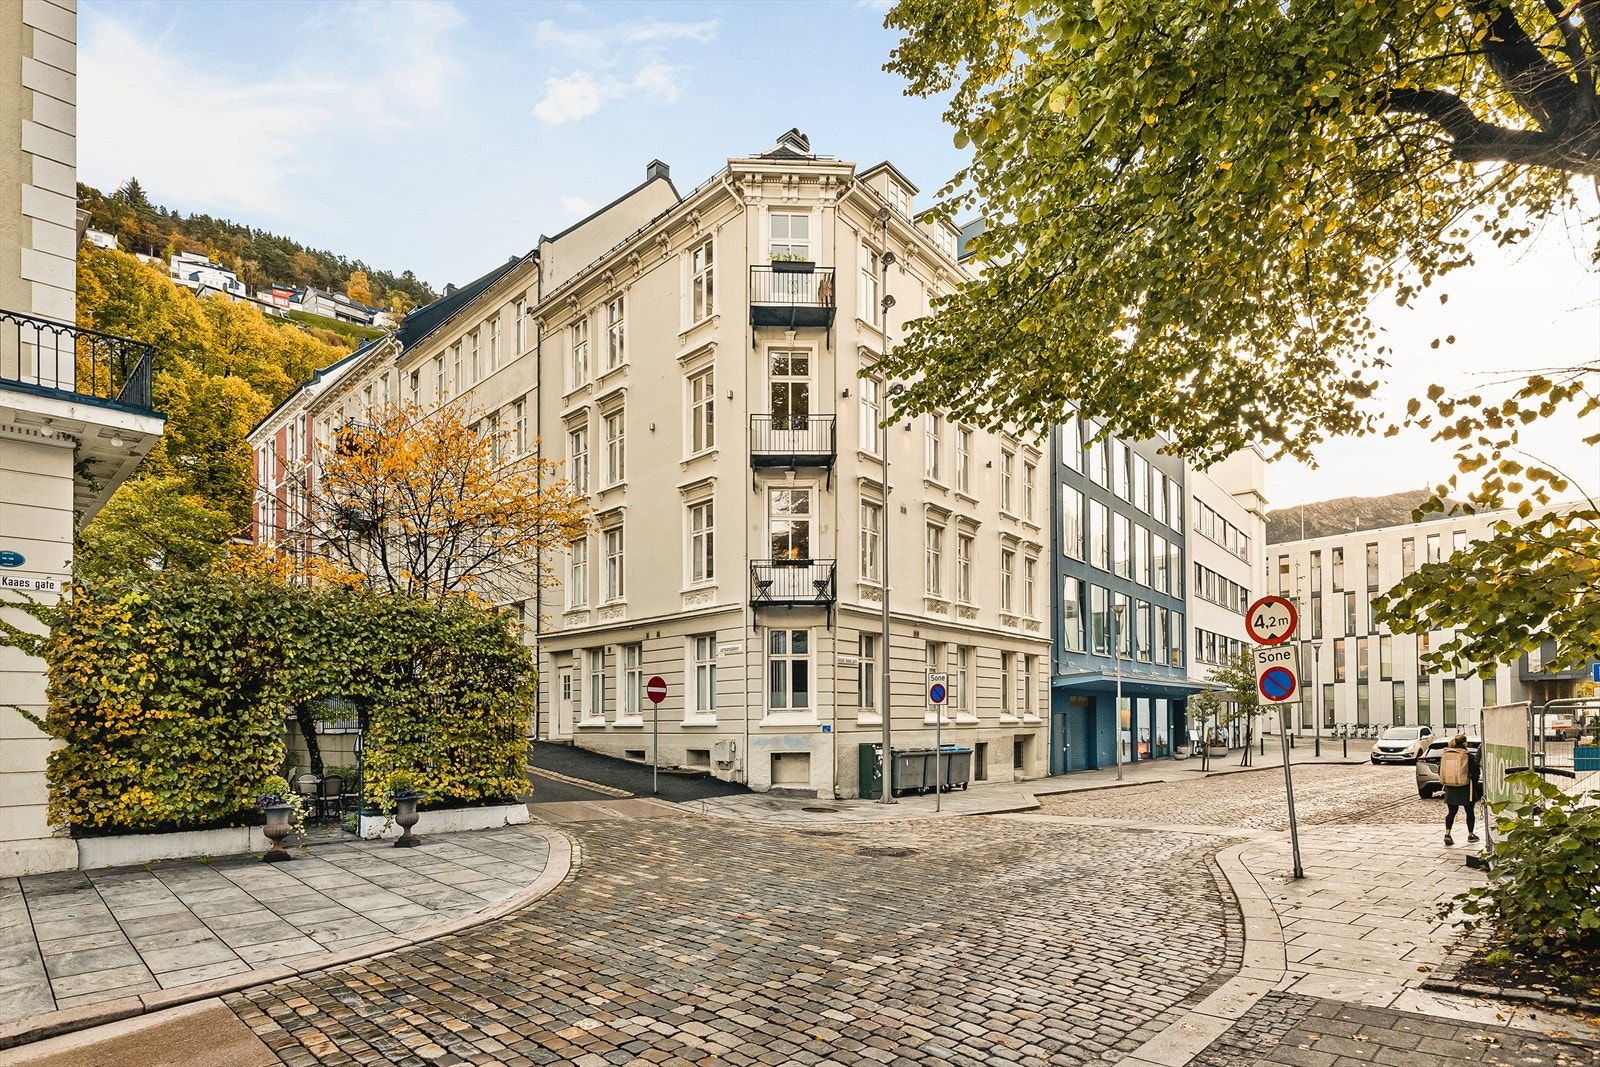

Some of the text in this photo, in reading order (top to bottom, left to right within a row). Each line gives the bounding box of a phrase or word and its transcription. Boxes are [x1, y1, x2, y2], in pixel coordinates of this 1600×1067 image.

[2, 577, 55, 590] Kaaes gate
[1258, 651, 1291, 664] Sone
